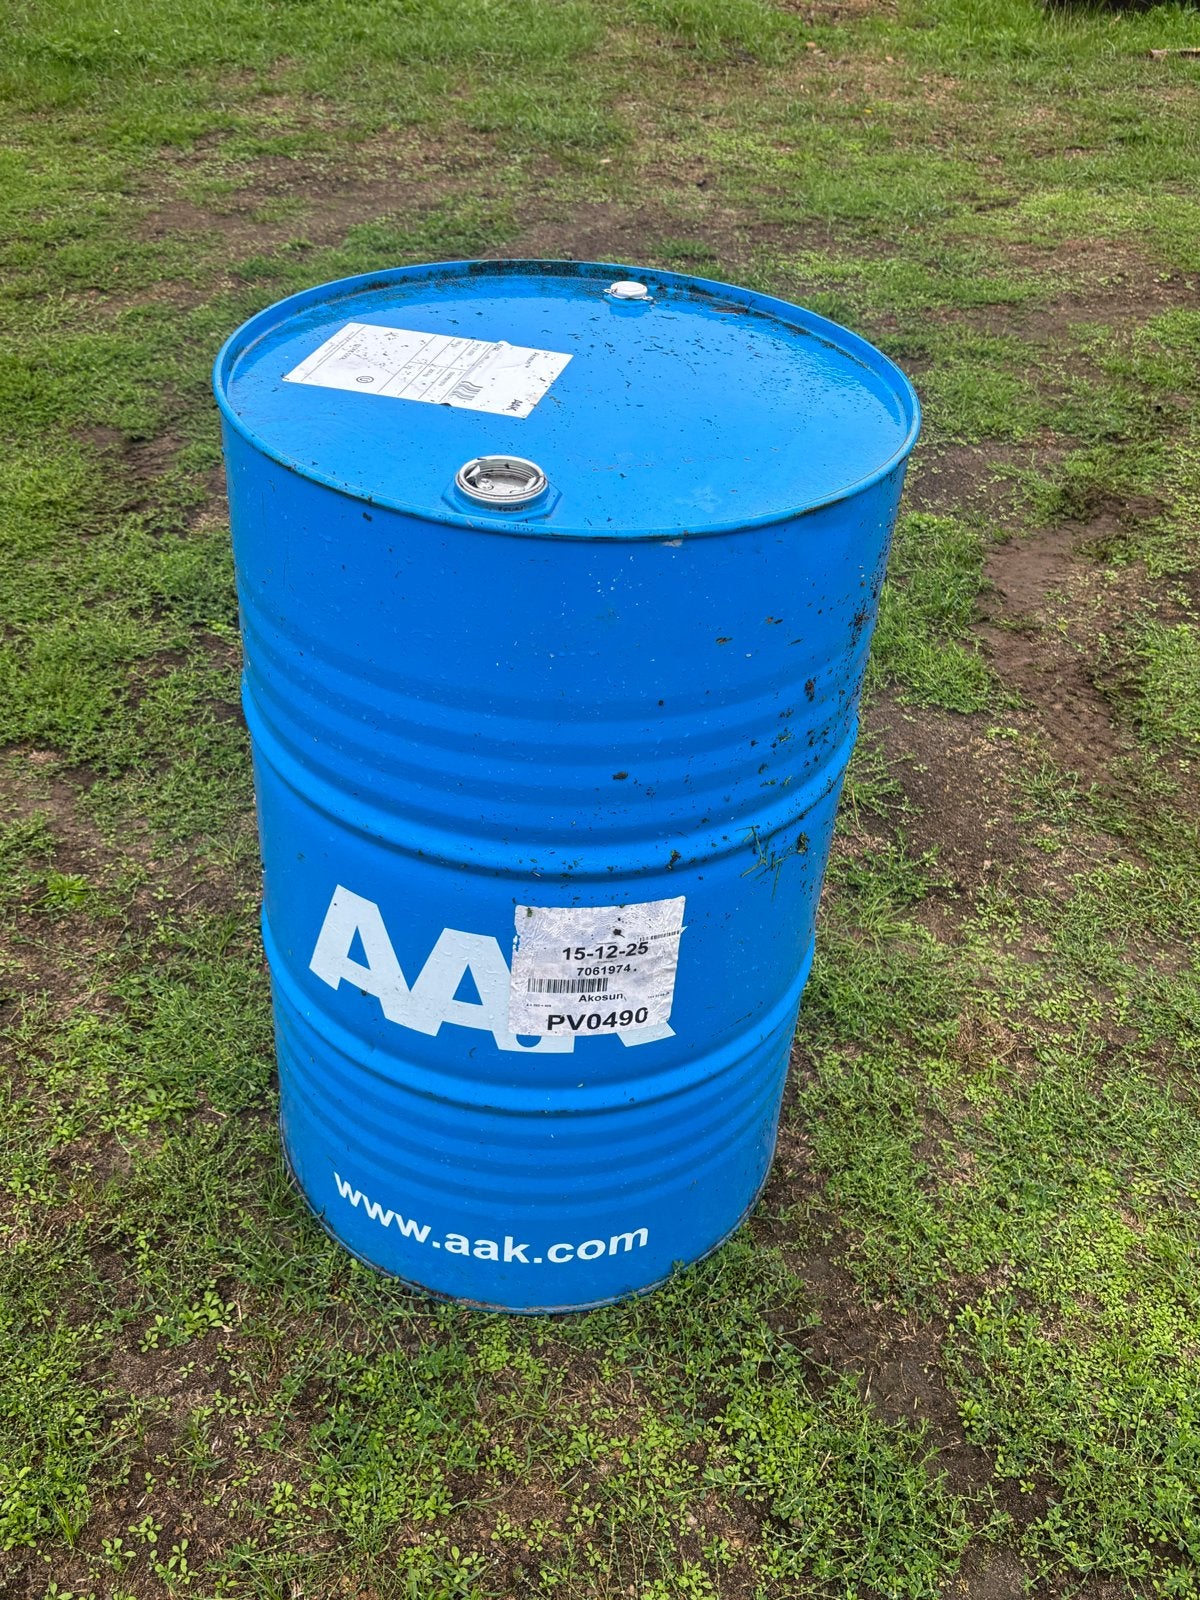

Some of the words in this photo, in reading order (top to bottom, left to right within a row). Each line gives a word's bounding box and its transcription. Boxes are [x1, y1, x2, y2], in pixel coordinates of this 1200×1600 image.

[562, 942, 649, 961] 15-12-25
[309, 884, 677, 1053] AA
[578, 993, 623, 1003] Akosun
[547, 1007, 649, 1031] PV0490
[334, 1171, 649, 1264] www.aak.com
